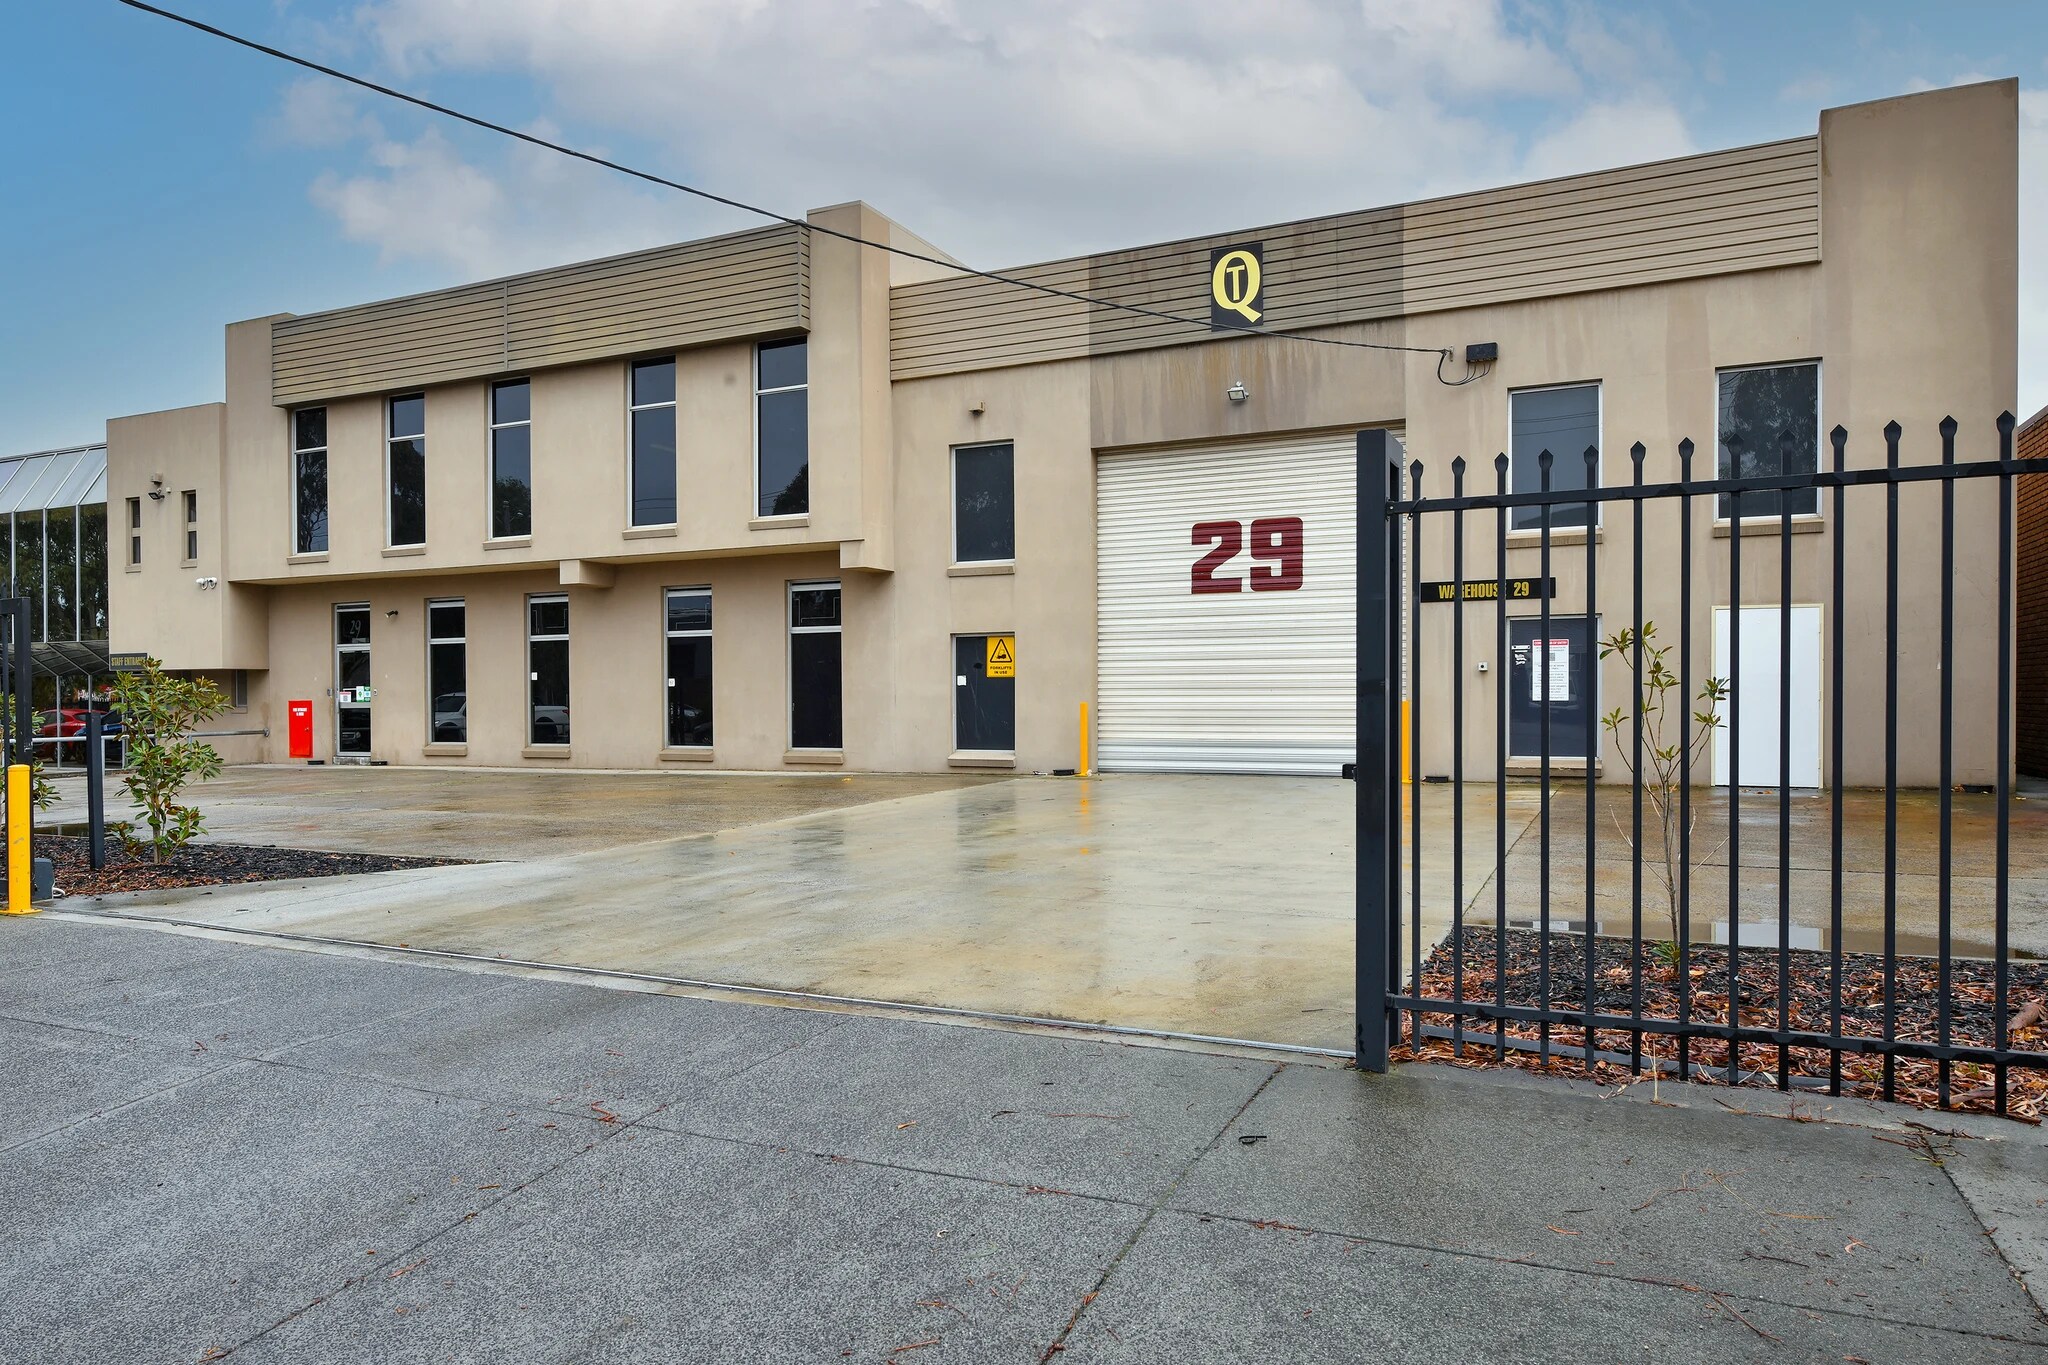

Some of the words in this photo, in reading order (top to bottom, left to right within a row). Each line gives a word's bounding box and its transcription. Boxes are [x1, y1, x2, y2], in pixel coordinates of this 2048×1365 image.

[1191, 516, 1303, 594] 29
[1438, 582, 1506, 599] WAEHOUS
[1513, 581, 1530, 597] 29
[350, 619, 361, 639] 29
[111, 657, 123, 667] STAFF
